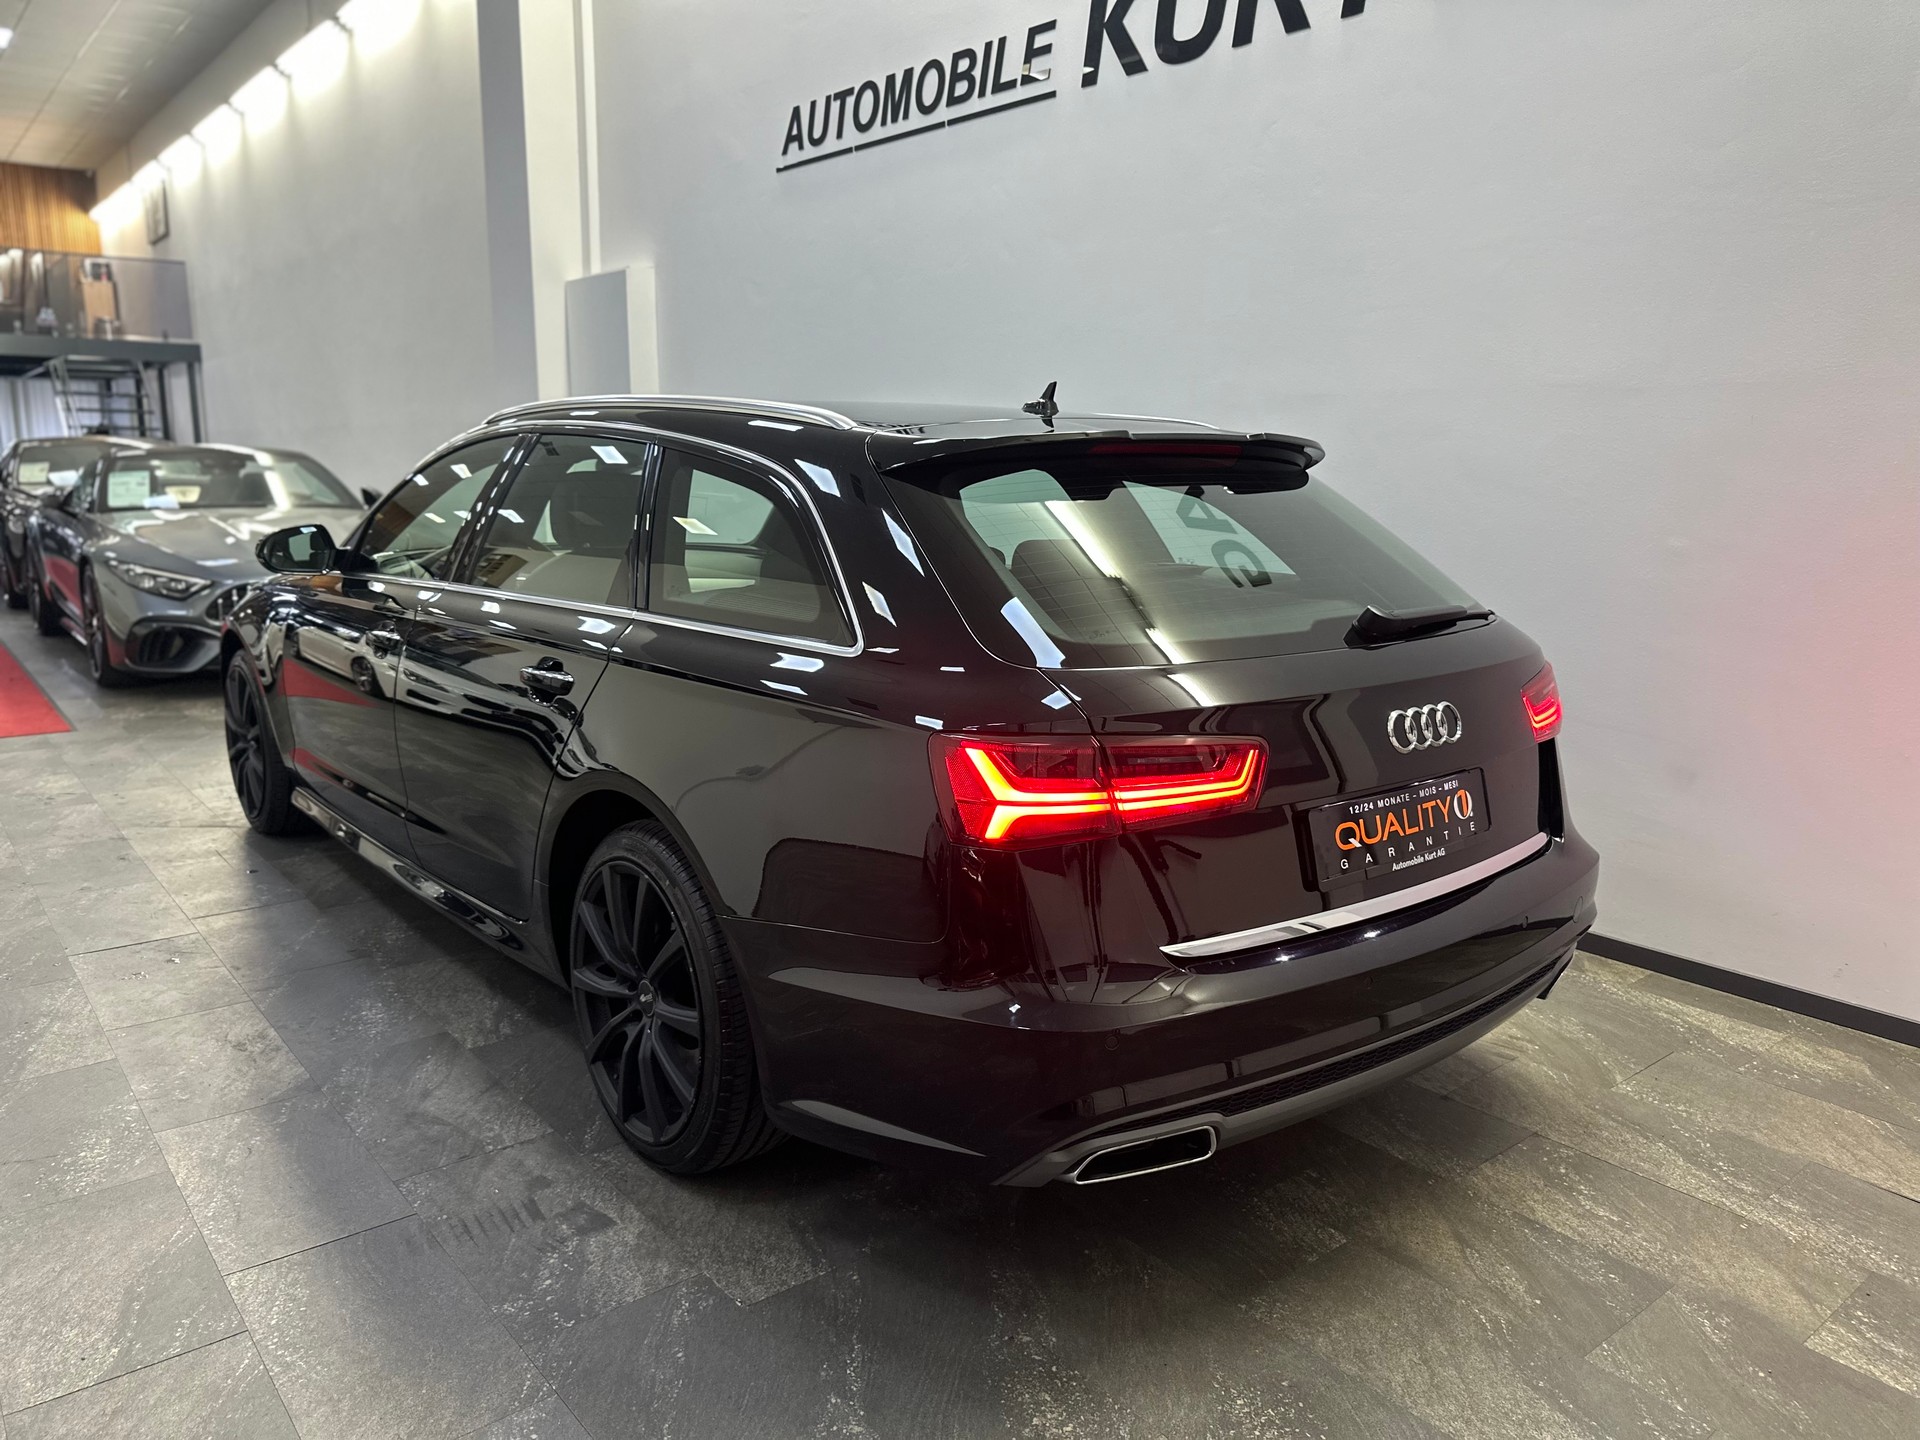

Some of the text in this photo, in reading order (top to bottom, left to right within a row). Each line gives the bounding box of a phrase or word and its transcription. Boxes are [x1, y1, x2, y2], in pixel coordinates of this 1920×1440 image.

[782, 0, 1365, 156] AUTOMOBILE KU
[1349, 803, 1374, 815] 12/24
[1377, 793, 1410, 809] MONATE
[1419, 786, 1437, 797] MOIS
[1443, 779, 1459, 791] MESI
[1340, 821, 1476, 870] GARANTIE
[1392, 847, 1446, 872] Automobile Kurt AG
